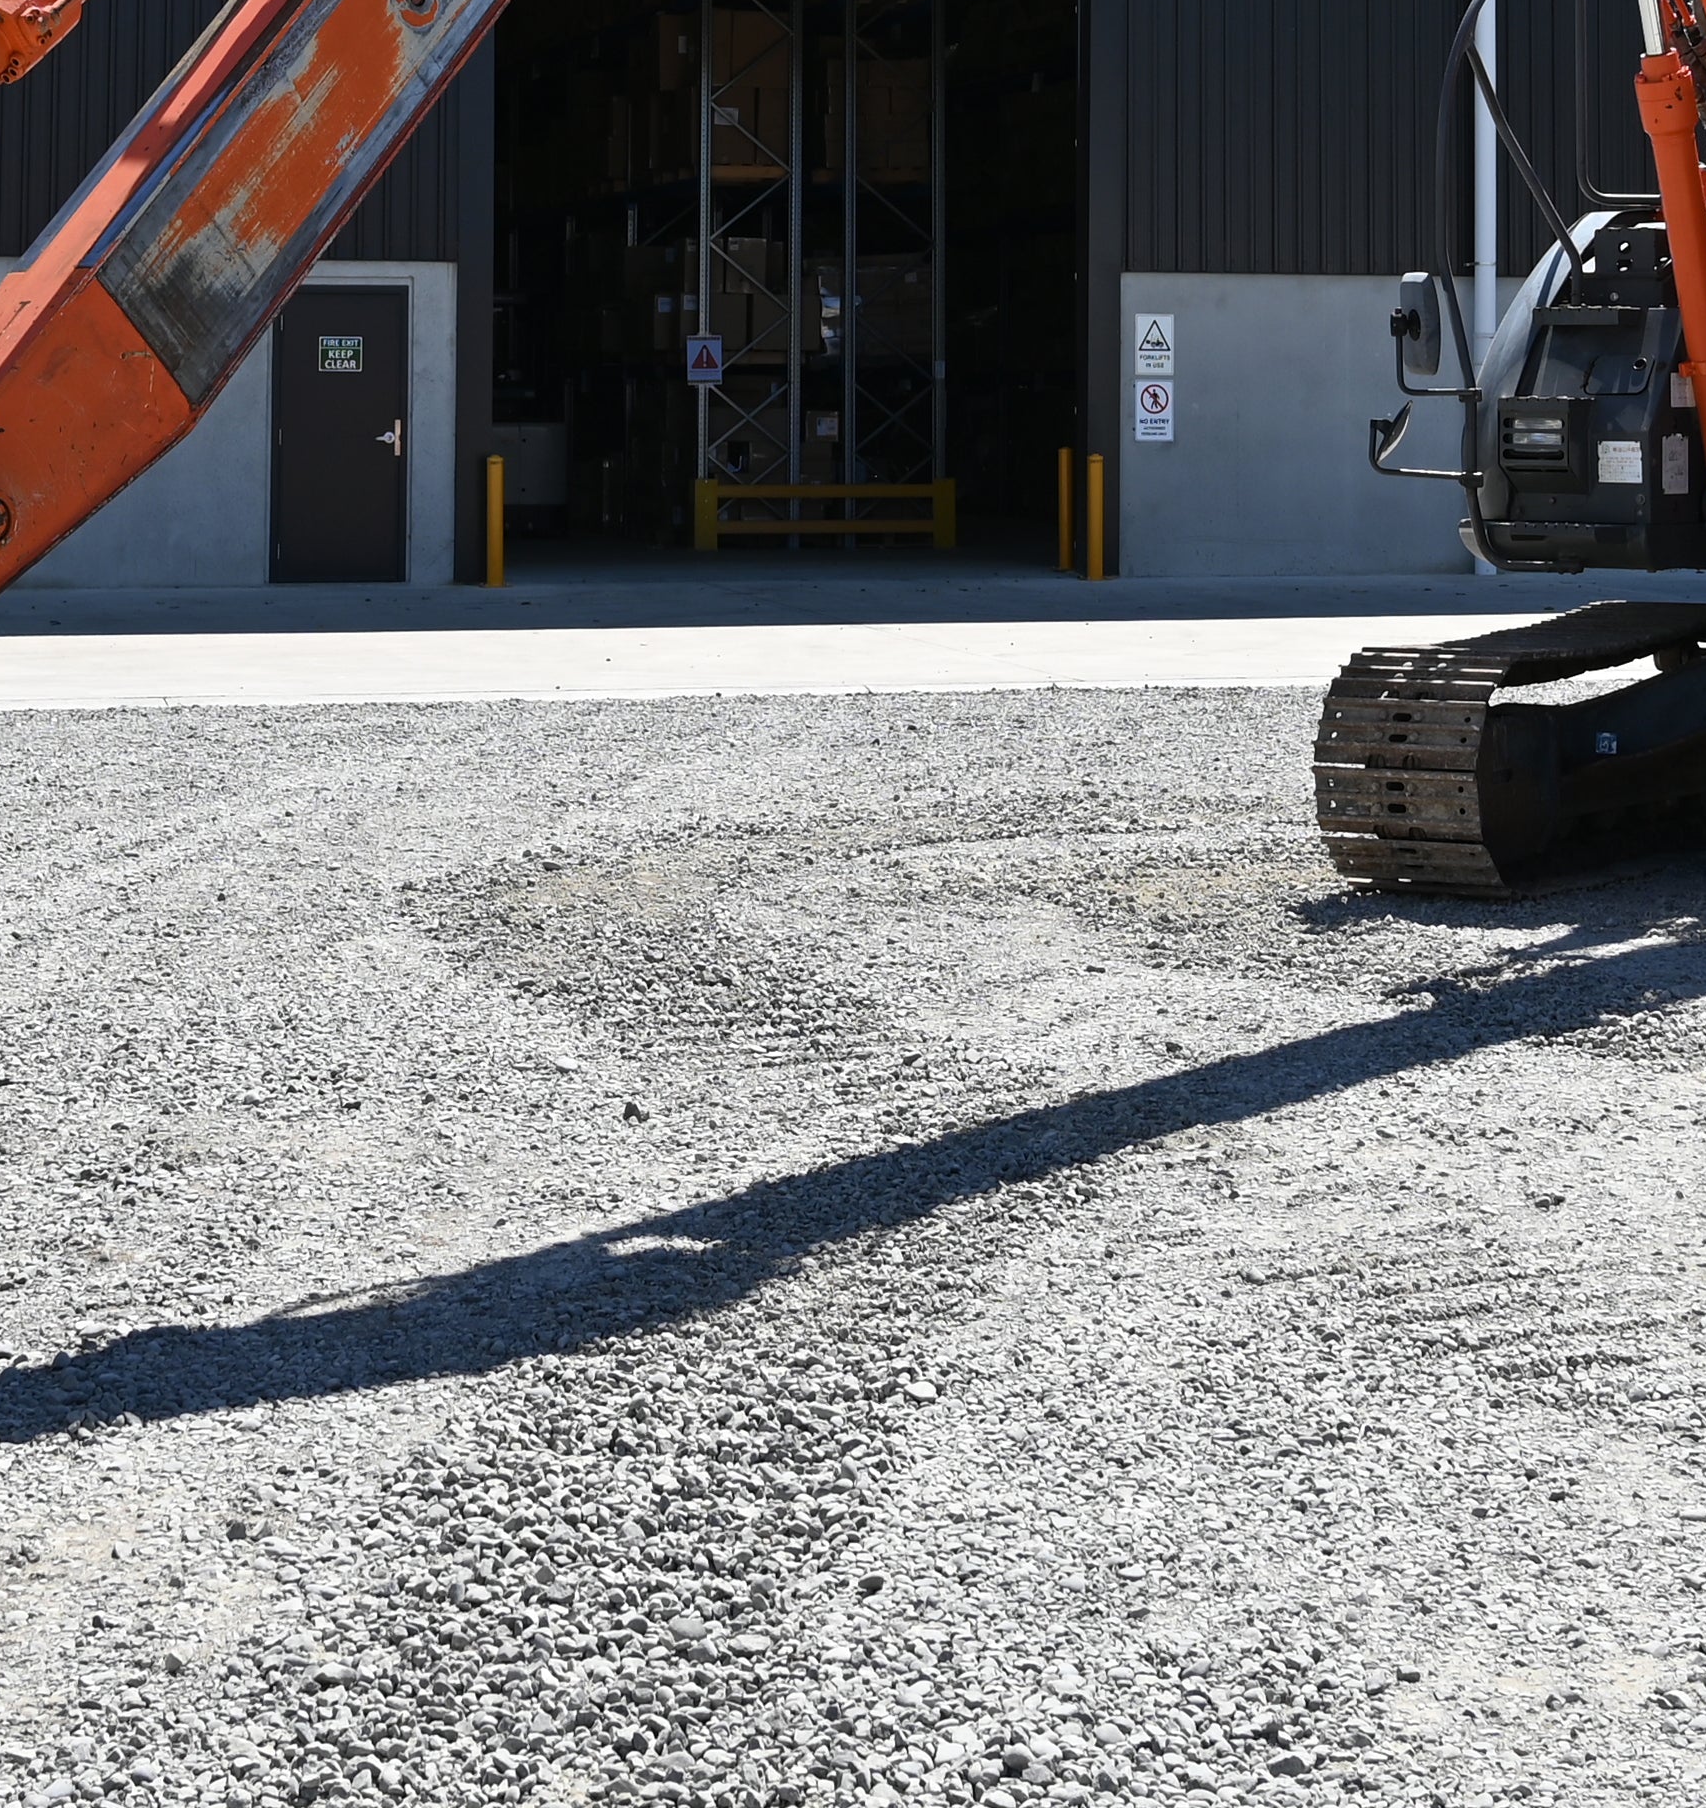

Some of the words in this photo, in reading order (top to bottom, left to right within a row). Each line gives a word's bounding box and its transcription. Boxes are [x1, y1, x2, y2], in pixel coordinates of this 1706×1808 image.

[323, 339, 340, 347] FIRE
[341, 339, 359, 347] EXIT
[328, 349, 354, 359] KEEP
[324, 359, 357, 369] CLEAR
